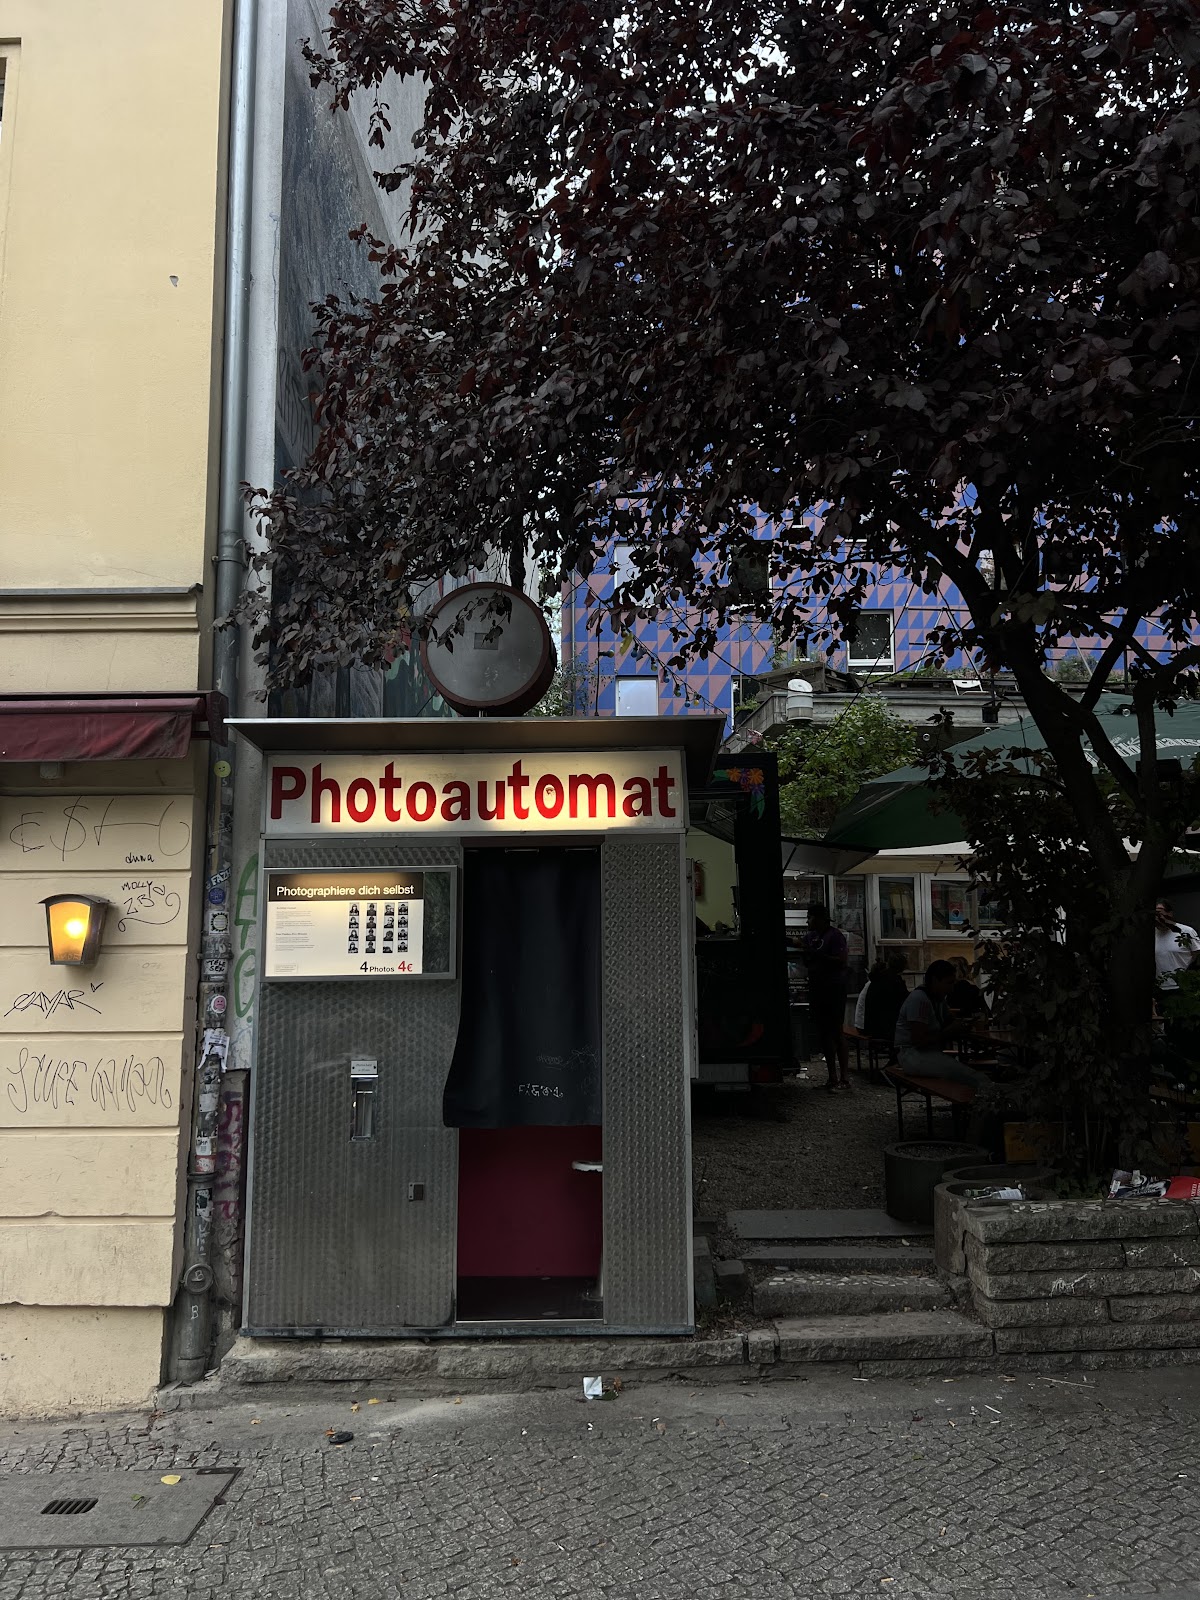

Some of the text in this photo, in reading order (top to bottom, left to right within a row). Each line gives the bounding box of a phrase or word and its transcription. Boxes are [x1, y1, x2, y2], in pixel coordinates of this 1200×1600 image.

[270, 759, 677, 824] Photoautomat
[276, 884, 414, 898] Photographiere dich selbst
[359, 960, 413, 973] 4 Photos 4€
